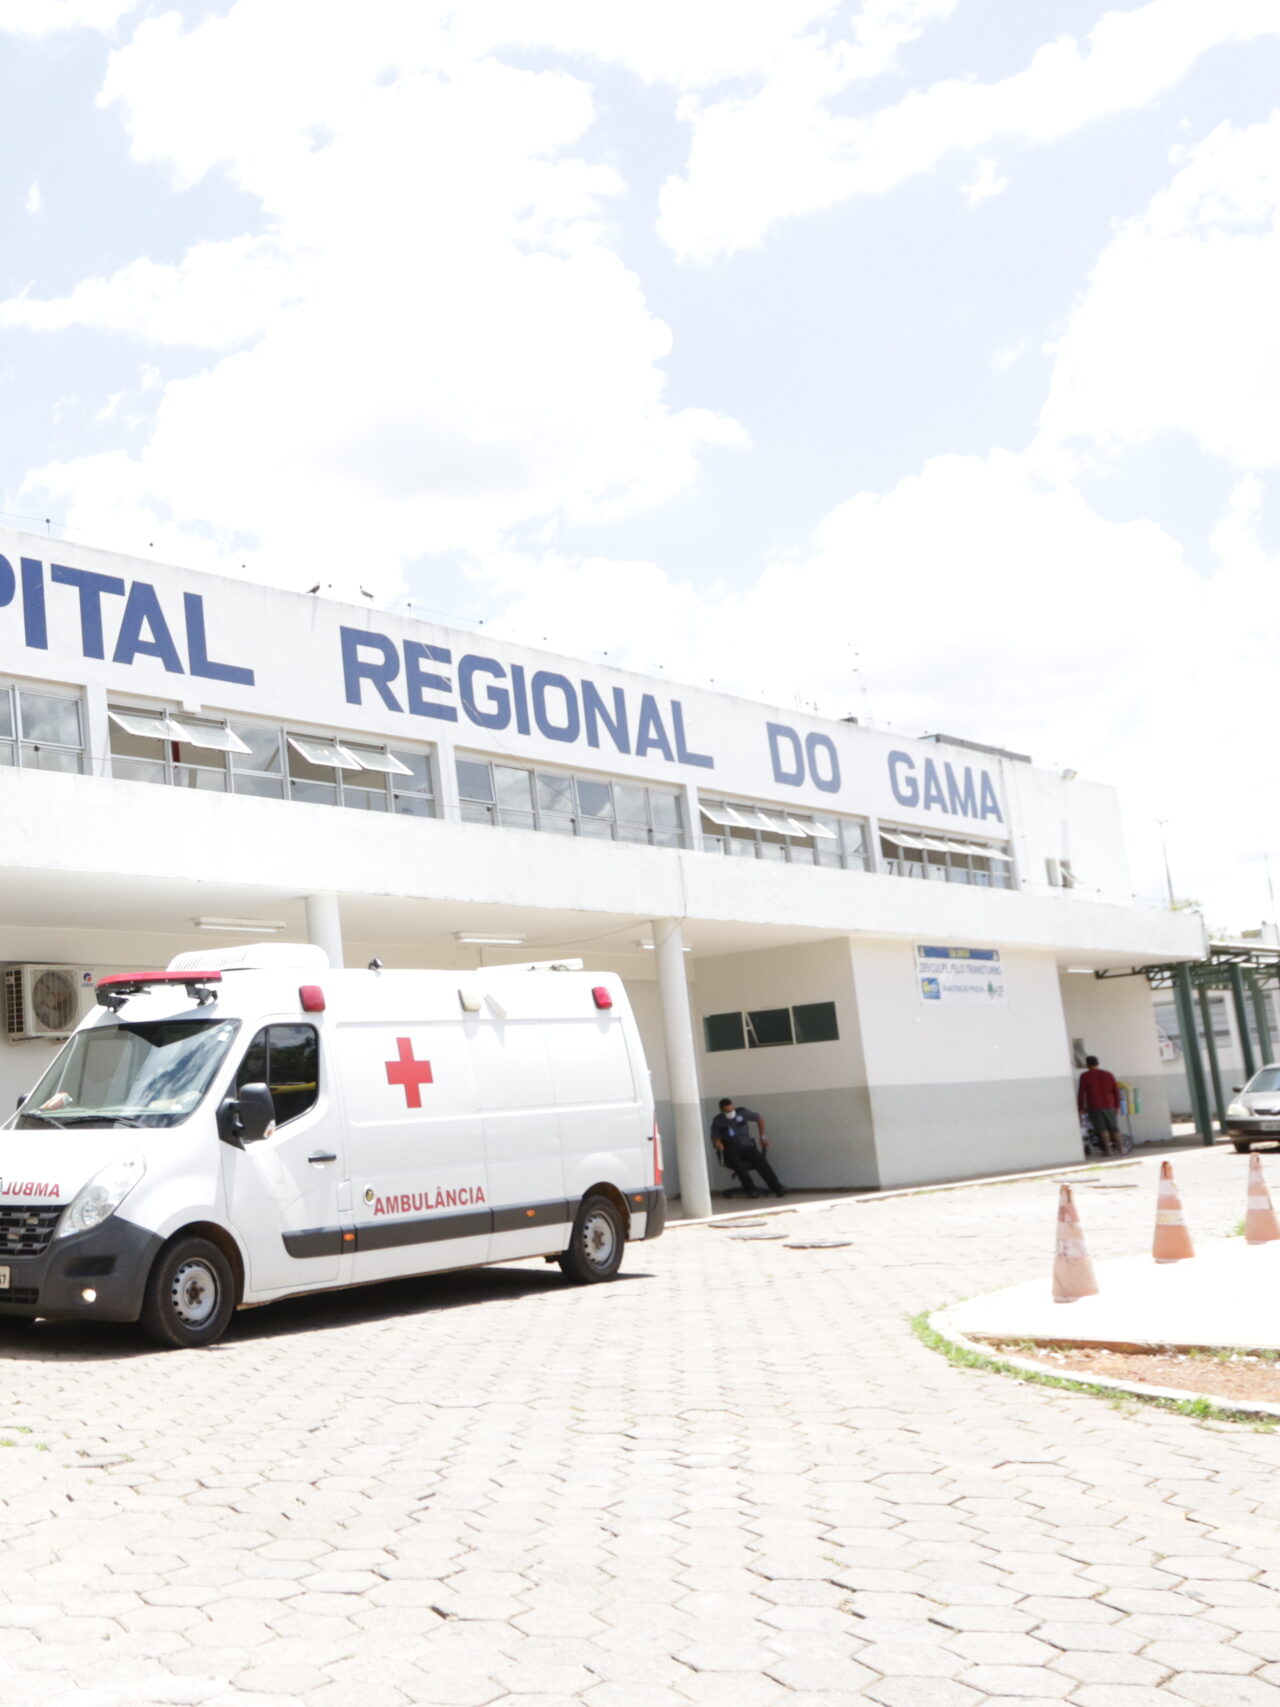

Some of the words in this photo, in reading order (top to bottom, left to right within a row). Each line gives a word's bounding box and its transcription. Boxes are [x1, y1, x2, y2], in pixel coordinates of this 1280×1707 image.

[340, 626, 714, 769] REGIONAL
[766, 721, 841, 794] DO
[888, 750, 1004, 824] GAMA
[373, 1186, 486, 1216] AMBULÂNCIA
